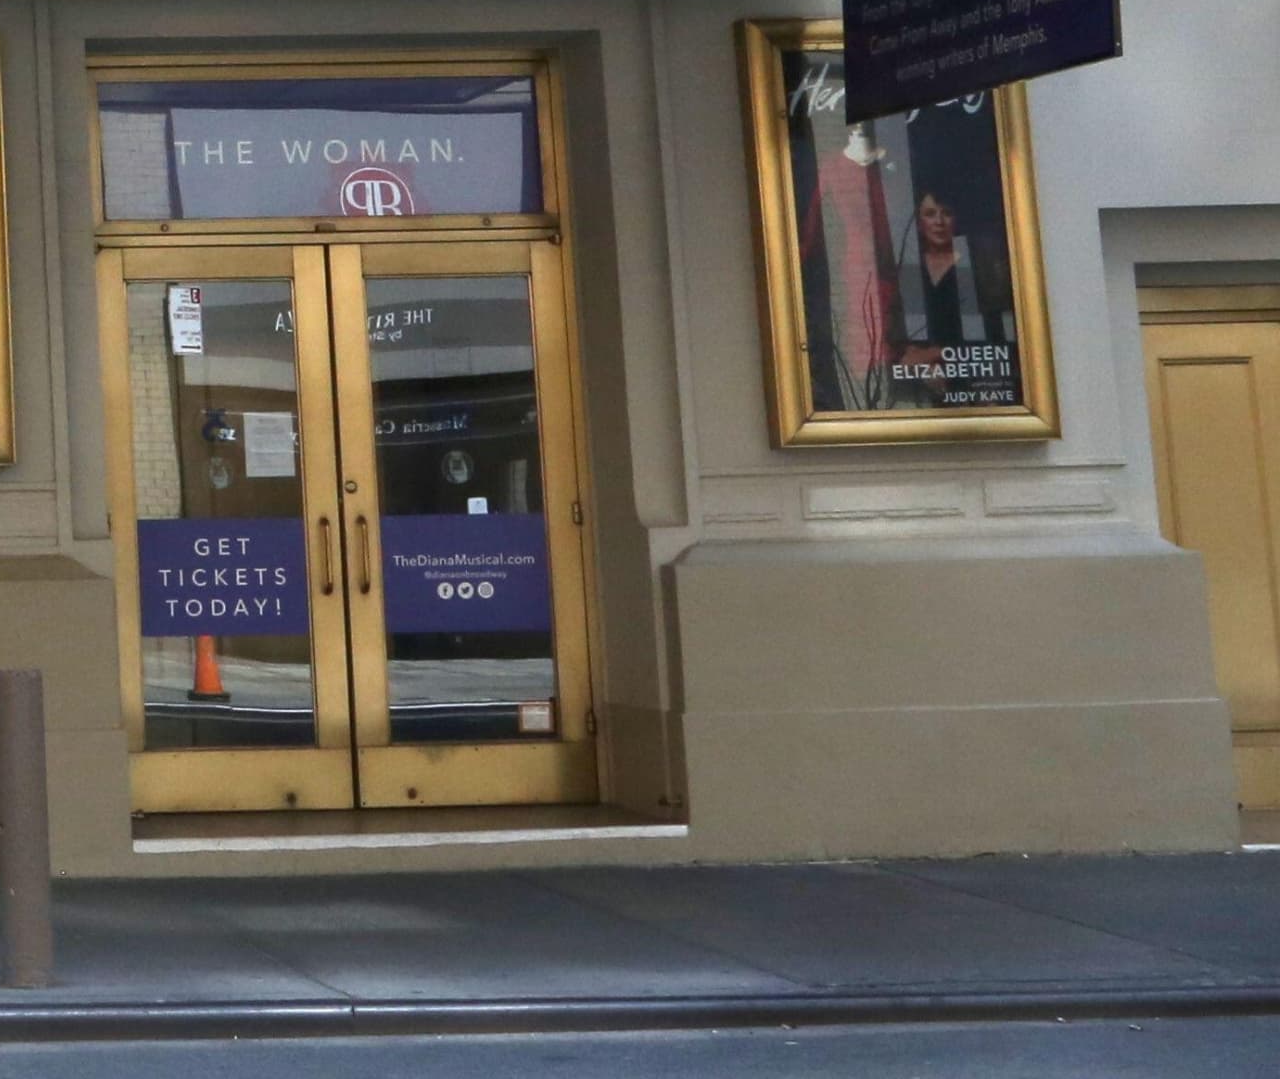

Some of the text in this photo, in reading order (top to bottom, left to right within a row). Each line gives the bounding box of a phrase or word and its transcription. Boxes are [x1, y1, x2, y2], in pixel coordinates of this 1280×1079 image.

[930, 18, 957, 38] Away
[959, 9, 980, 29] and
[983, 0, 1002, 21] the
[938, 47, 975, 70] writers
[976, 35, 989, 59] of
[992, 23, 1048, 55] Memphis.
[790, 62, 845, 117] Her
[174, 138, 465, 165] THE WOMAN.
[941, 346, 1009, 361] QUEEN
[892, 362, 1010, 379] ELIZABETH II
[943, 390, 1013, 403] JUDY KAYE
[194, 538, 250, 556] GET
[392, 553, 536, 567] TheDianaMusical.com
[159, 568, 287, 587] TICKETS
[165, 598, 281, 617] TODAY!
